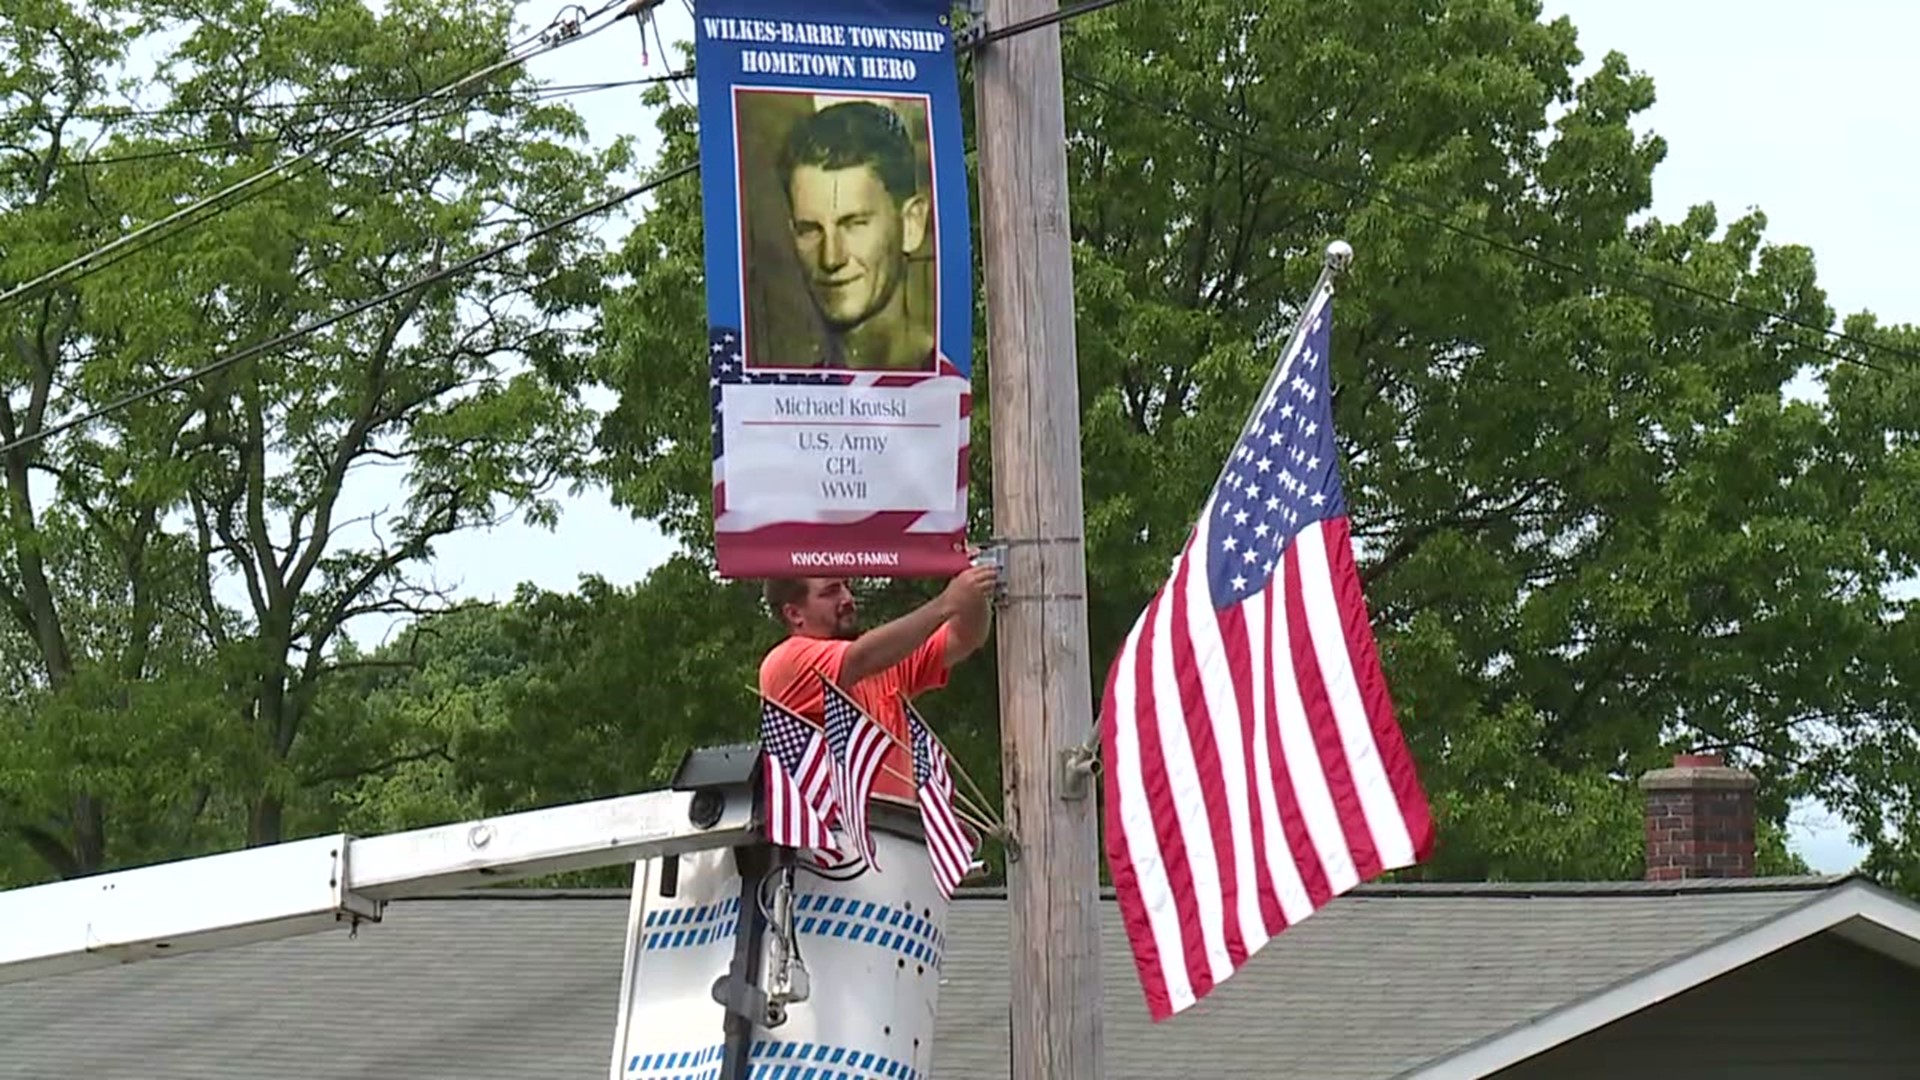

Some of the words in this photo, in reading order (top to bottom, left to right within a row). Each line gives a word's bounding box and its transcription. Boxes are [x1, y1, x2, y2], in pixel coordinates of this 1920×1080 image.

[703, 17, 844, 46] WILKES-BARRE
[848, 27, 945, 52] TOWNSHIP
[742, 50, 855, 77] HOMETOWN
[862, 56, 916, 80] HERO
[775, 397, 844, 416] Michael
[799, 432, 833, 451] U.S.
[840, 433, 888, 454] Army
[821, 481, 867, 499] WWII
[791, 552, 854, 566] KWOCHKO
[857, 552, 899, 566] FAMILY
